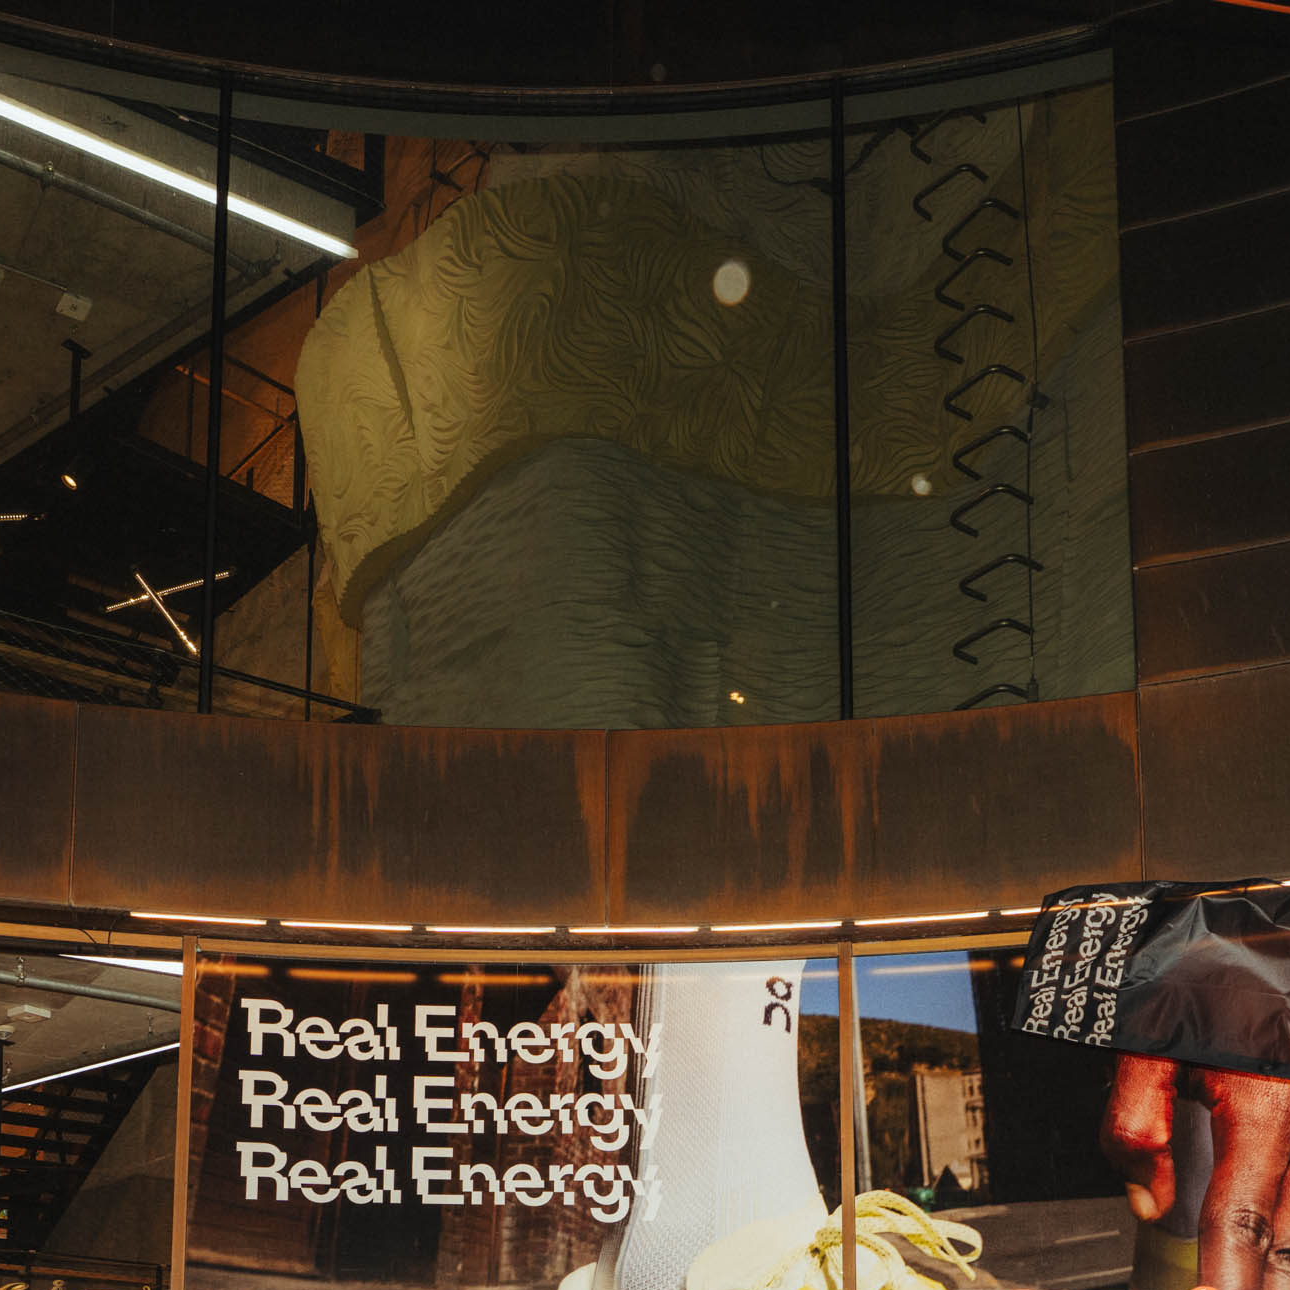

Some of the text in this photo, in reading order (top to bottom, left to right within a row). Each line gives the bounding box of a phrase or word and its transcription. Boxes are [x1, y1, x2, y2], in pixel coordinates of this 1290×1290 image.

[1022, 898, 1085, 1036] Real Energy
[1053, 893, 1119, 1042] Real Energy
[1085, 895, 1154, 1047] Real Energy
[241, 998, 663, 1080] Real Energy
[238, 1069, 663, 1151] Real Energy
[236, 1141, 663, 1223] Real Energy
